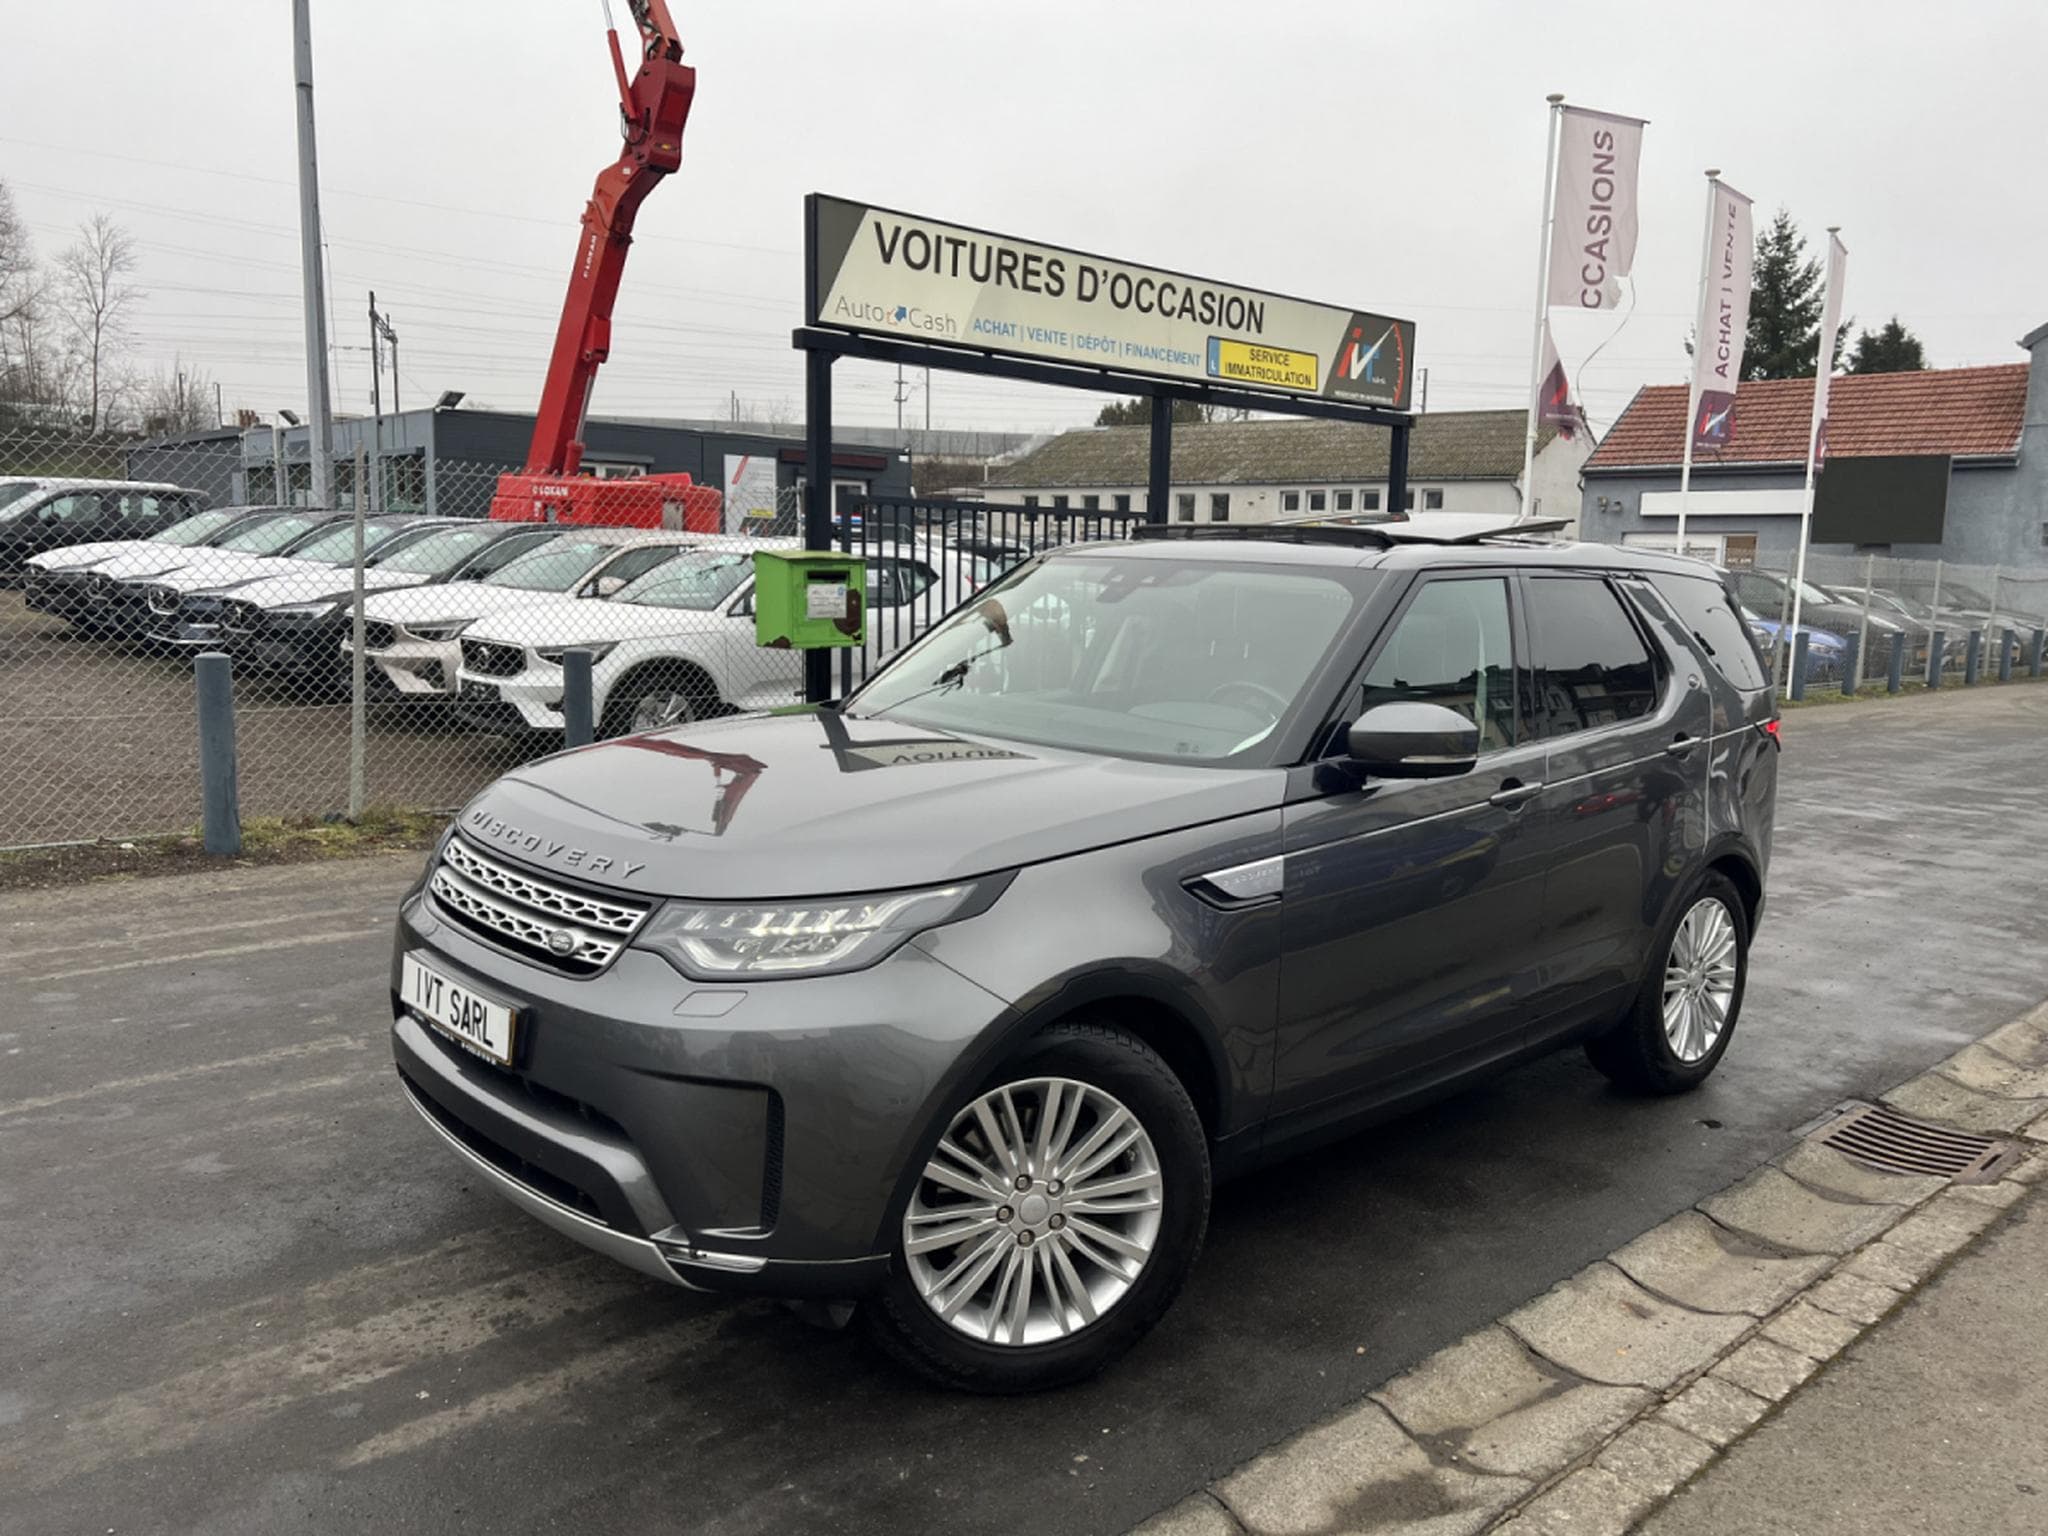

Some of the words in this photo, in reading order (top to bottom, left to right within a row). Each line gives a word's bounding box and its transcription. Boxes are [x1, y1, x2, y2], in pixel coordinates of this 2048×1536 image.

[873, 221, 1065, 297] VOITURES
[1077, 265, 1264, 333] D'OCCASION
[1715, 299, 1731, 378] ACHAT
[1723, 203, 1737, 279] VENTE
[835, 295, 885, 322] Auto
[908, 308, 957, 333] Cash
[973, 318, 1017, 338] ACHAT
[1027, 327, 1067, 346] VENTE
[1077, 334, 1116, 353] DÉPÔT
[1126, 343, 1200, 366] FINANCEMENT
[1225, 362, 1312, 386] IMMATRICULATION
[1249, 348, 1291, 367] SERVICE
[473, 809, 646, 879] DISCOVERY
[416, 967, 444, 1014] IVT
[450, 989, 494, 1048] SARL
